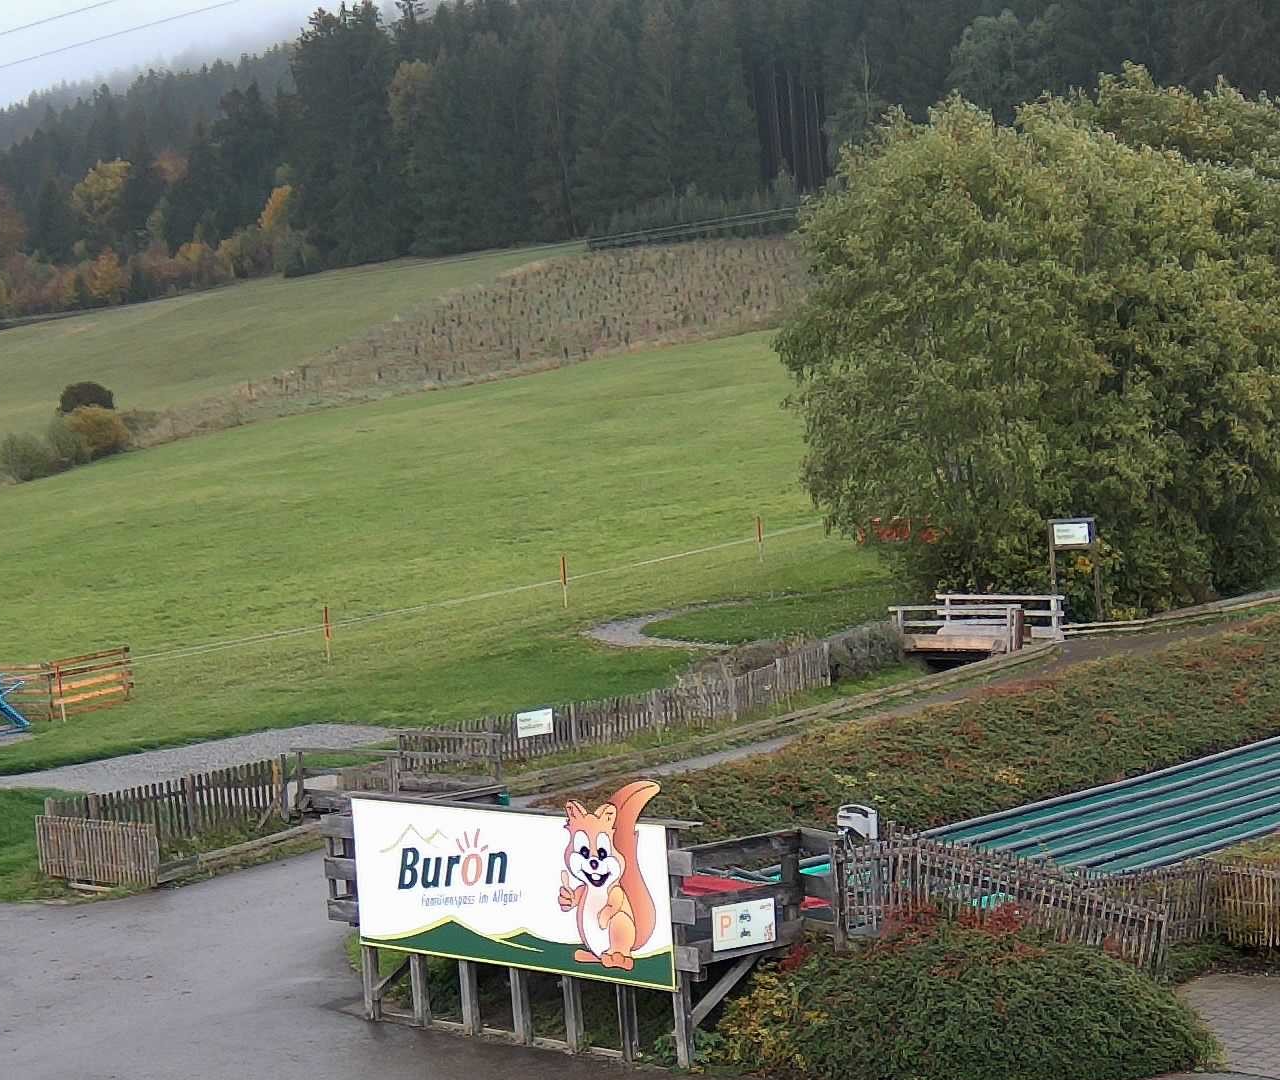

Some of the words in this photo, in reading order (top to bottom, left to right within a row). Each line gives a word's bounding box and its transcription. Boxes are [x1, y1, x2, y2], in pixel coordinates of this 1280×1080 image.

[397, 847, 508, 890] Buron
[479, 892, 489, 904] im
[720, 914, 732, 937] P
